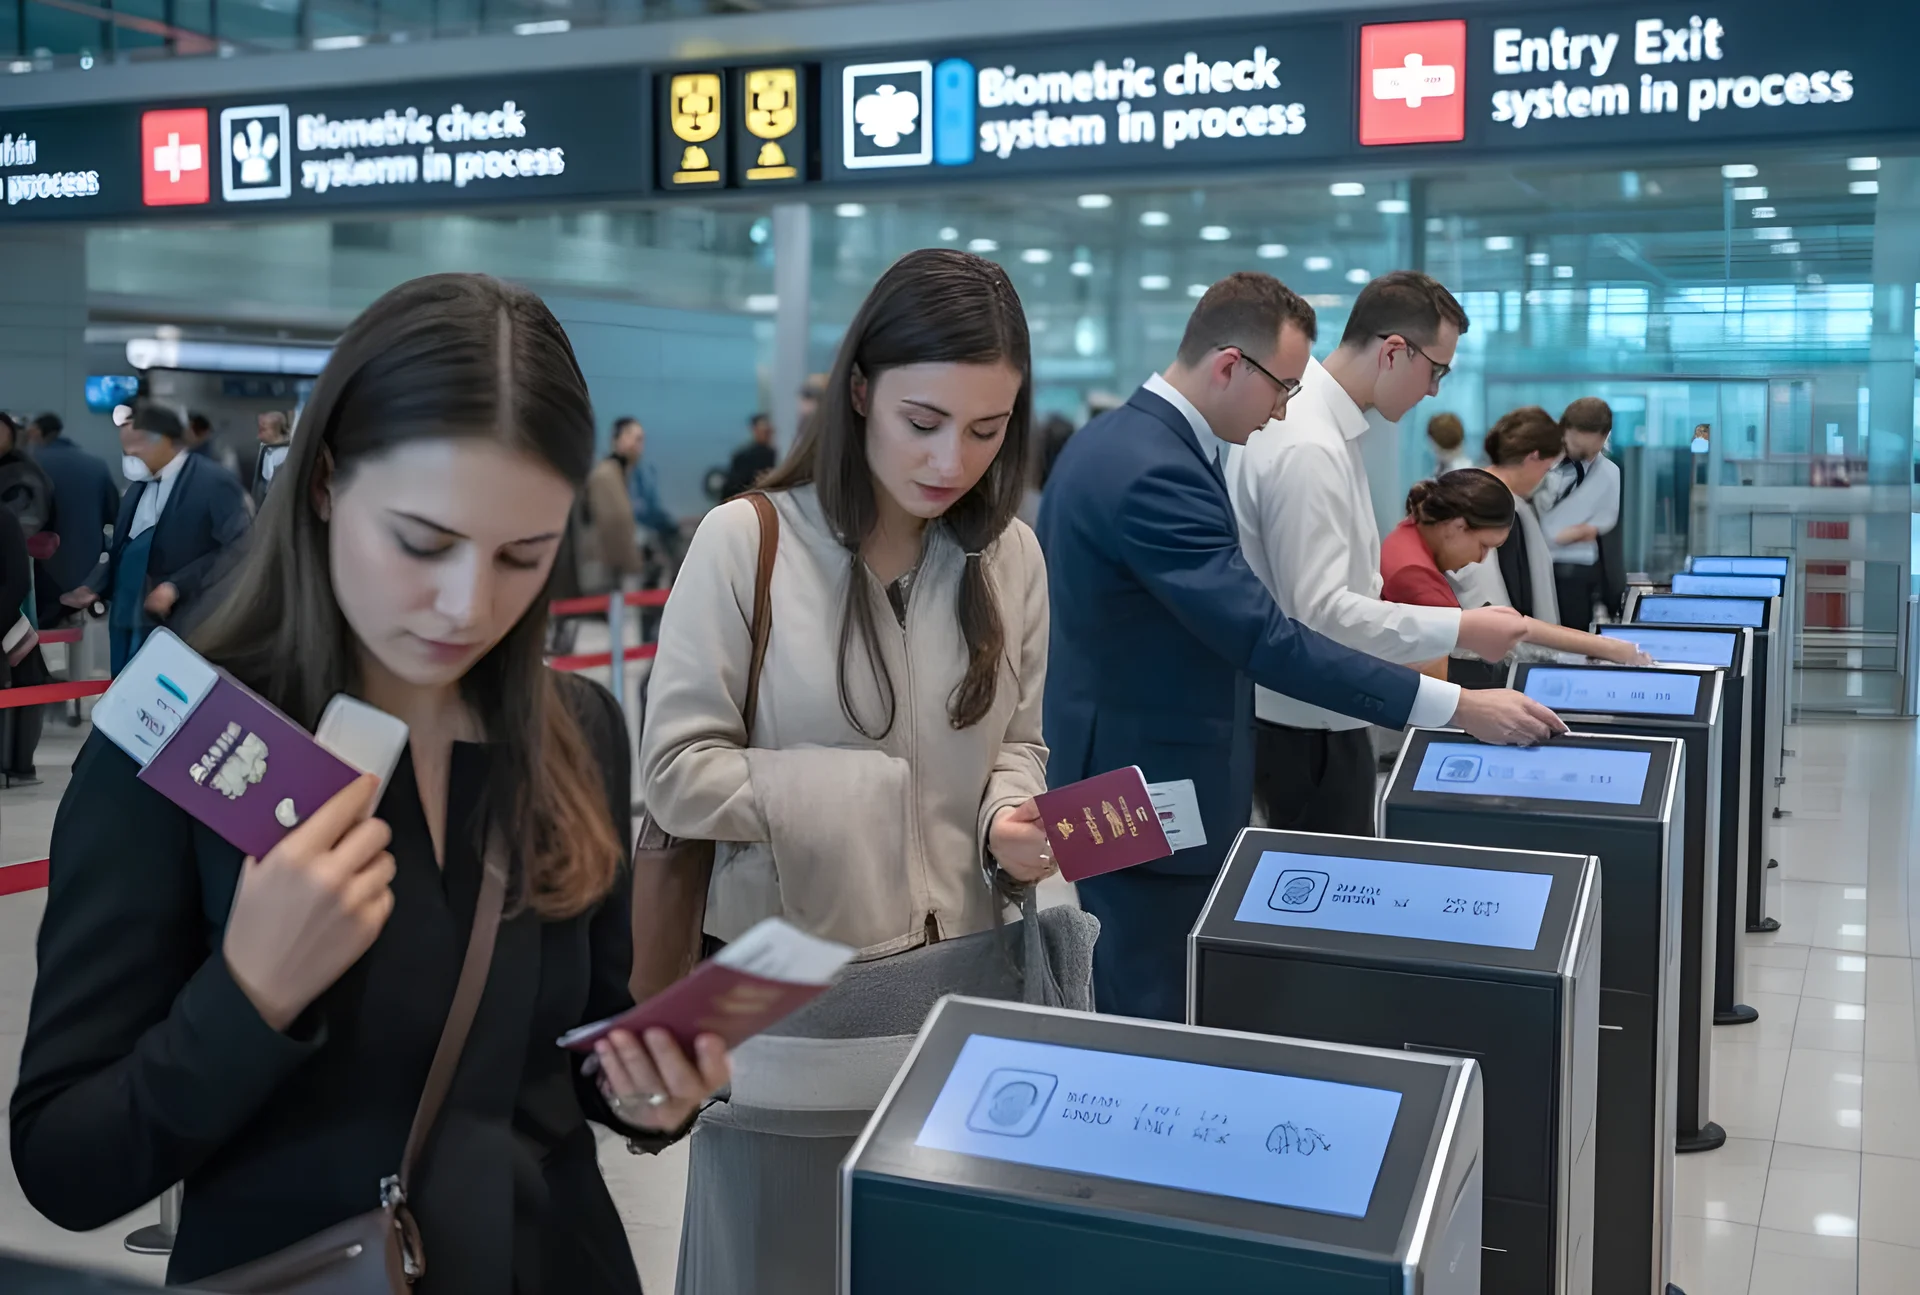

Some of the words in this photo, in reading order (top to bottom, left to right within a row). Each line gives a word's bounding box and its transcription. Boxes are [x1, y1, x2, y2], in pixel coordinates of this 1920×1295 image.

[1493, 26, 1620, 77] Entry
[1634, 15, 1725, 65] Exit
[978, 57, 1156, 107] Biometric
[1163, 45, 1281, 96] check
[1491, 80, 1630, 129] system
[1640, 73, 1679, 113] in
[1688, 69, 1854, 122] process
[436, 100, 526, 142] check
[980, 110, 1106, 159] system
[1117, 101, 1156, 143] in
[1163, 103, 1306, 150] process
[422, 146, 452, 183] in
